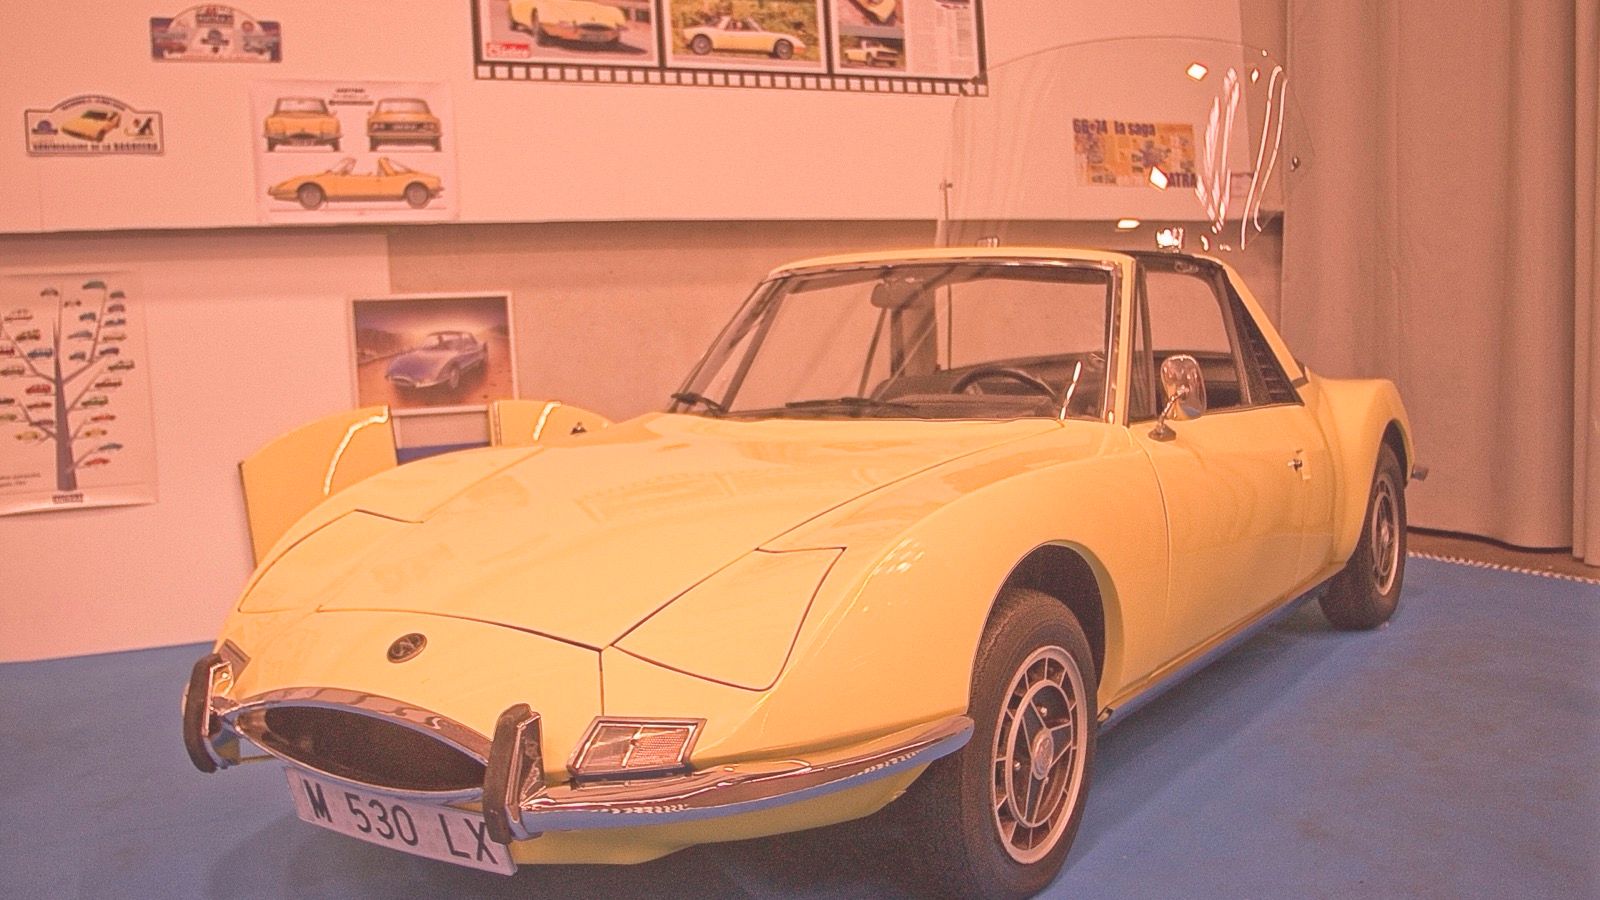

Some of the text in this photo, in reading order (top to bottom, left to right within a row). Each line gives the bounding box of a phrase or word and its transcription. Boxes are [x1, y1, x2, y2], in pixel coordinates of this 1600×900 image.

[1114, 120, 1126, 135] la
[1128, 122, 1156, 138] saga
[1166, 172, 1197, 188] ATRA
[303, 779, 498, 865] M 530 LX
